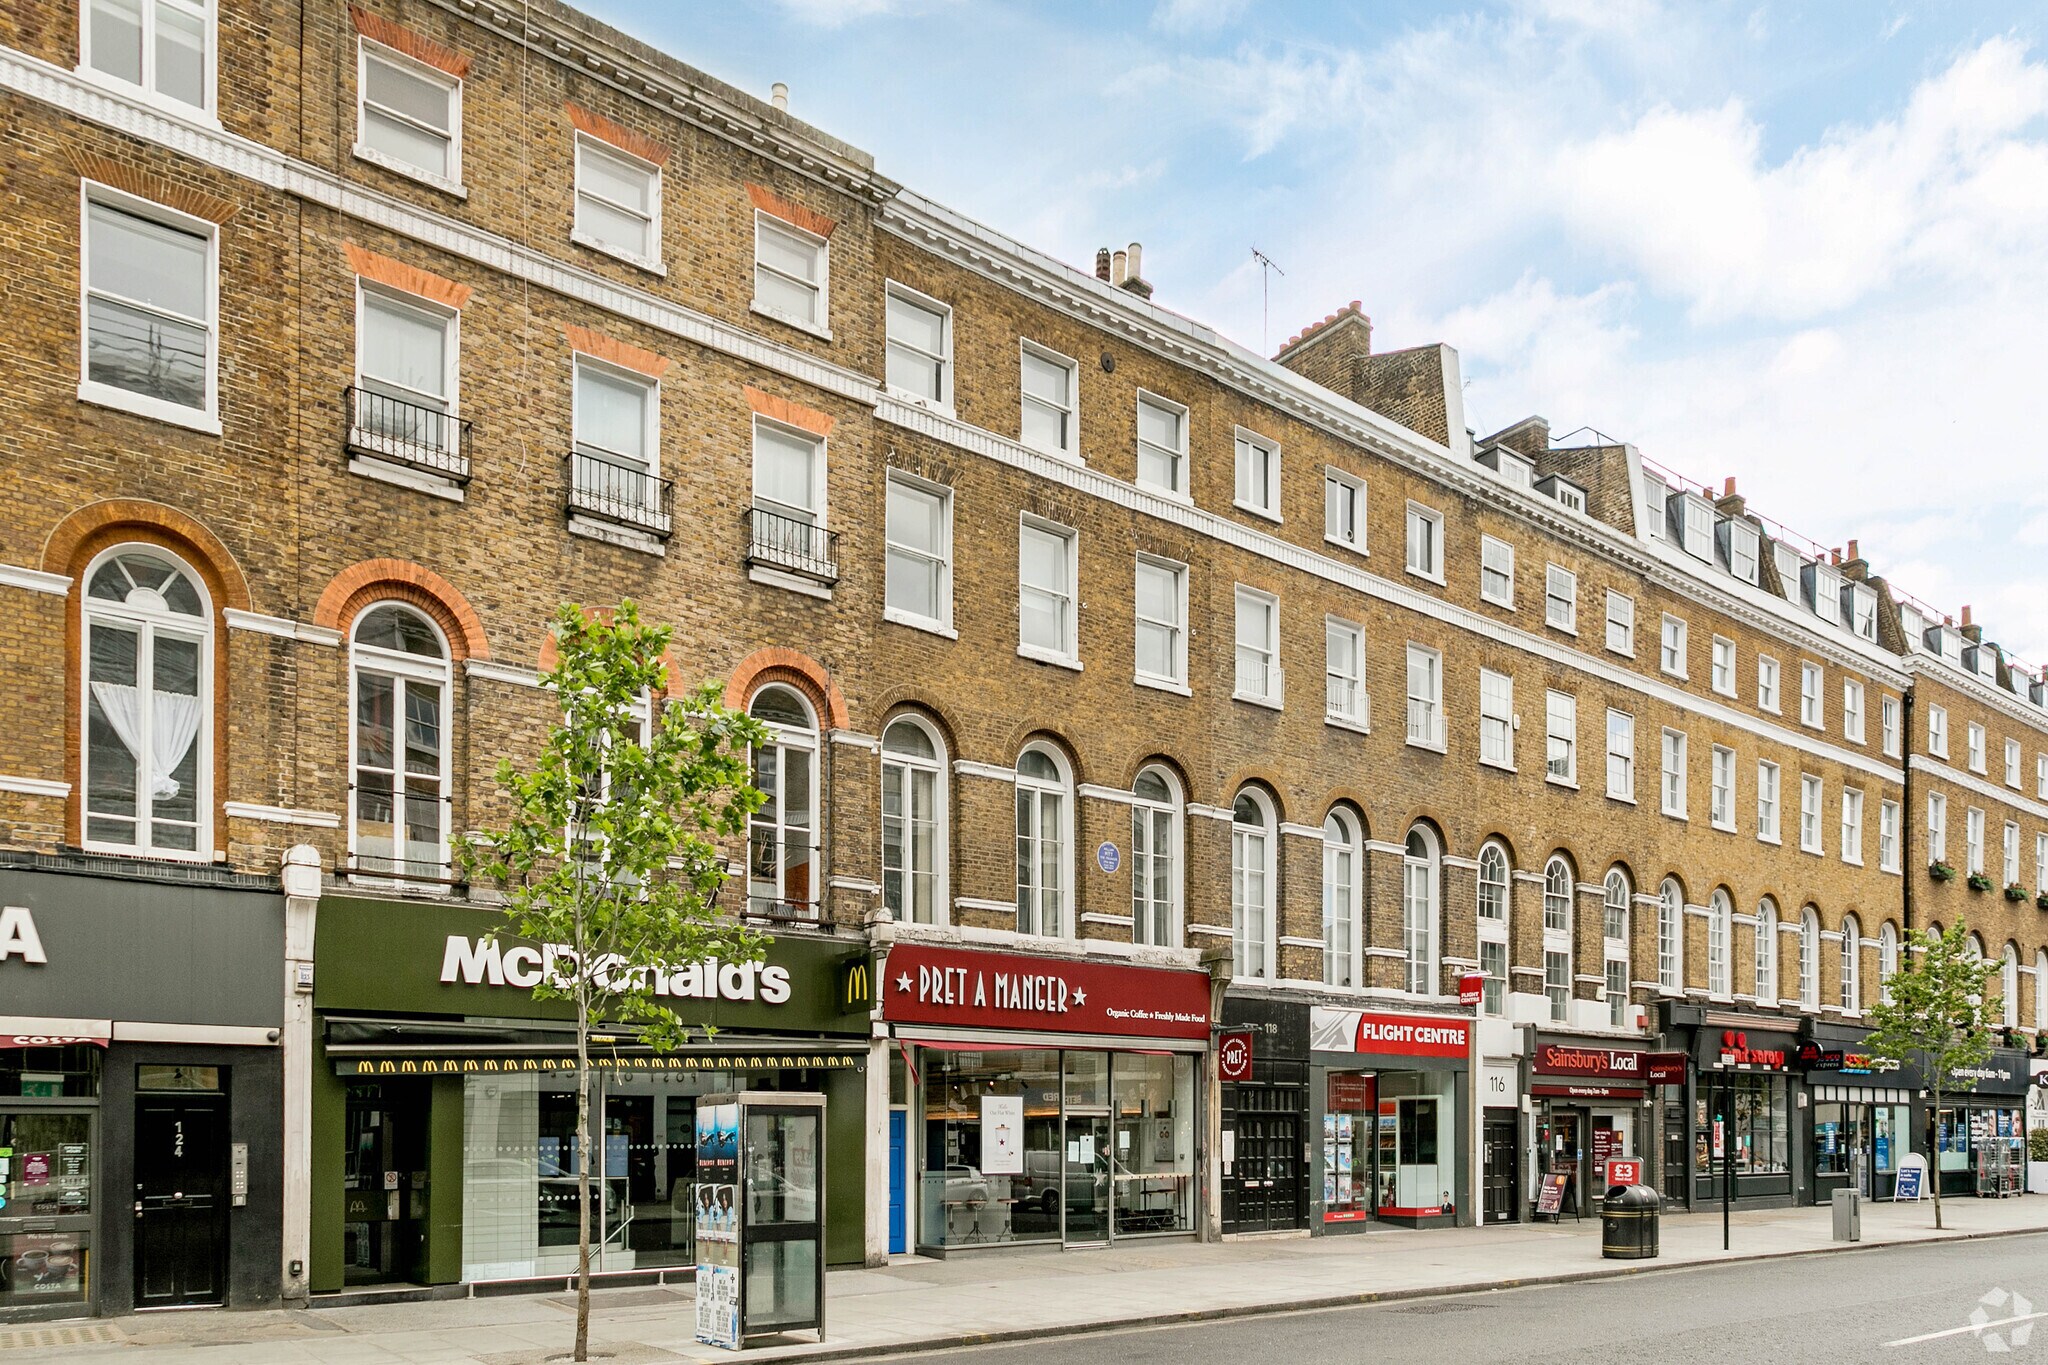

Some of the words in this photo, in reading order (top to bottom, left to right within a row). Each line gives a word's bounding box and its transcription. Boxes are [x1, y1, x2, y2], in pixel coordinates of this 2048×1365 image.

[440, 935, 791, 1004] McDonald's
[918, 964, 968, 1005] PRET
[974, 970, 988, 1007] A
[994, 971, 1069, 1014] MANGER
[1106, 1007, 1130, 1019] Organic
[1130, 1009, 1149, 1019] Coffee
[1154, 1011, 1175, 1022] Freshly
[1175, 1012, 1191, 1022] Made
[1191, 1013, 1206, 1023] Food
[1264, 1022, 1278, 1034] 118
[1363, 1022, 1414, 1042] FLIGHT
[1414, 1027, 1466, 1045] CENTRE
[1226, 1049, 1243, 1065] PRET
[1546, 1047, 1609, 1073] Sainsbury's
[1609, 1052, 1638, 1071] Local
[1650, 1065, 1683, 1073] Sainsbury's
[1650, 1070, 1666, 1078] Local
[1489, 1076, 1506, 1092] 116
[1614, 1163, 1634, 1178] £3
[33, 1282, 62, 1290] COSTA
